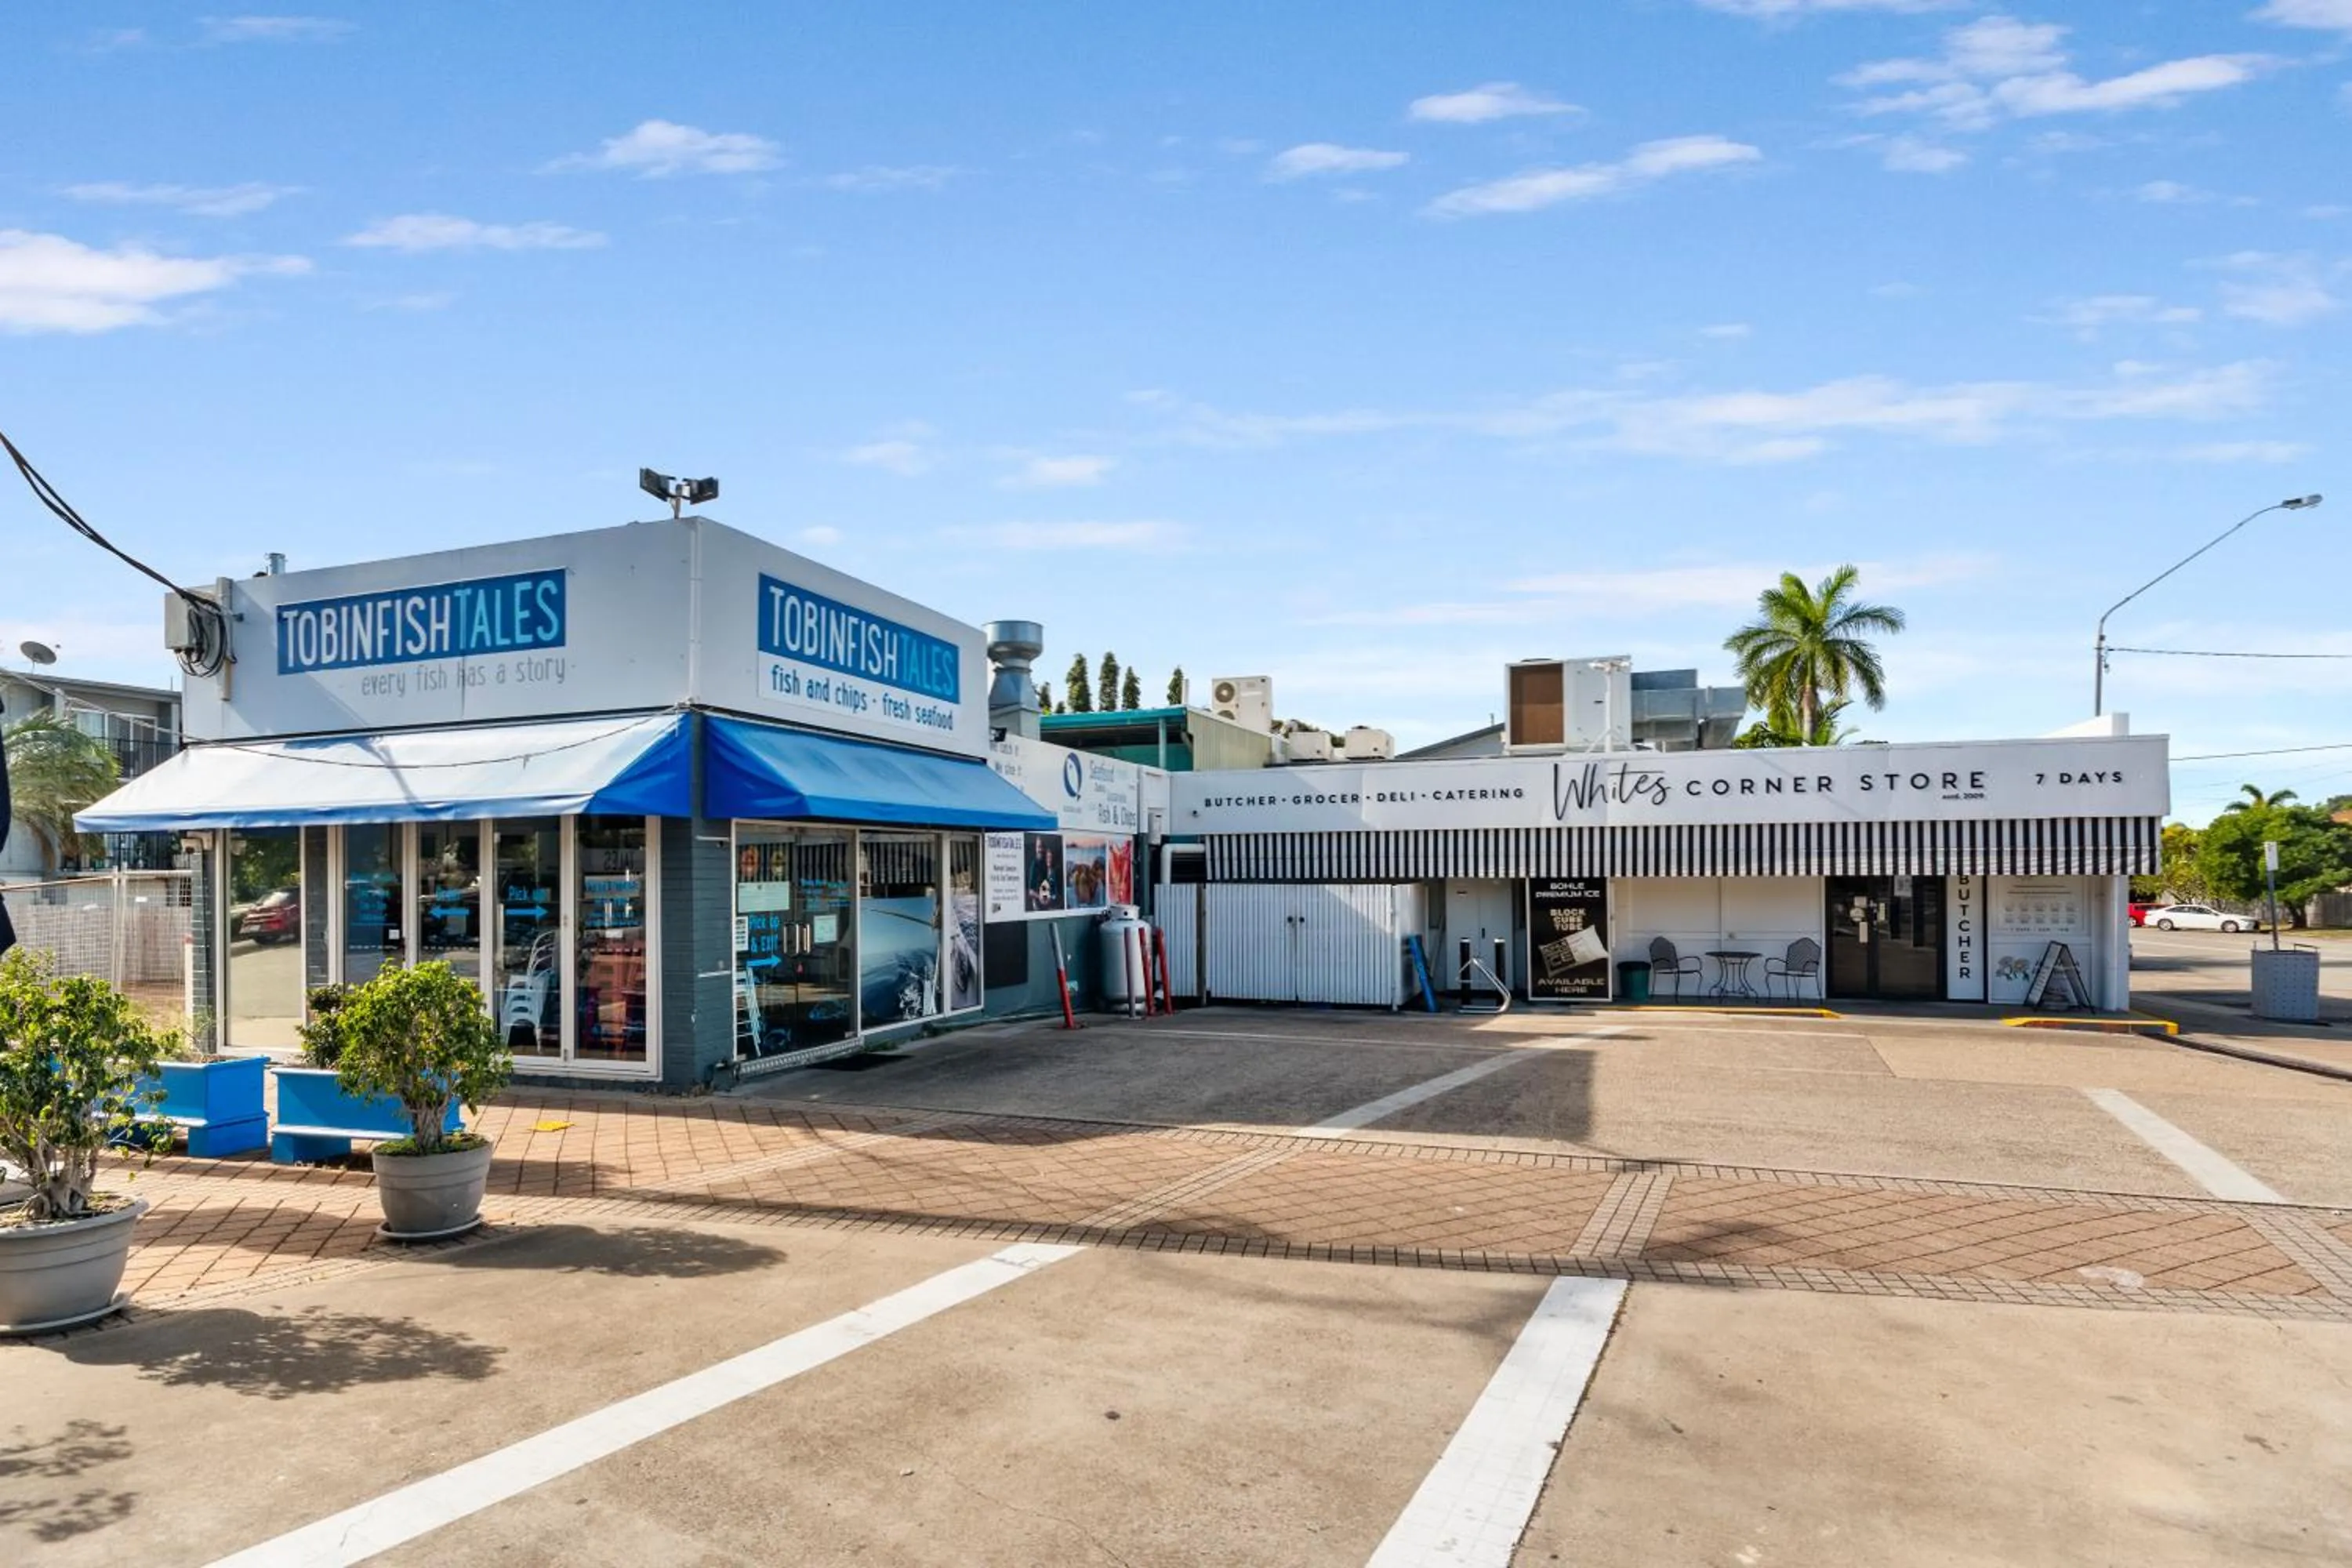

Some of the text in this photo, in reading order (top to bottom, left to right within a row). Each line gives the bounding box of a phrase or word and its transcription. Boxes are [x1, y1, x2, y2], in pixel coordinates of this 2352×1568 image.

[281, 580, 559, 667] TOBINFISHTALES
[769, 586, 954, 696] TOBINFISHTALES
[361, 657, 566, 698] every fish has a story
[771, 664, 953, 731] fish and chips fresh seafood
[1204, 762, 2124, 821] BUTCHER GROCER DELI CATERING Whites CORNER STORE 7 DAYS
